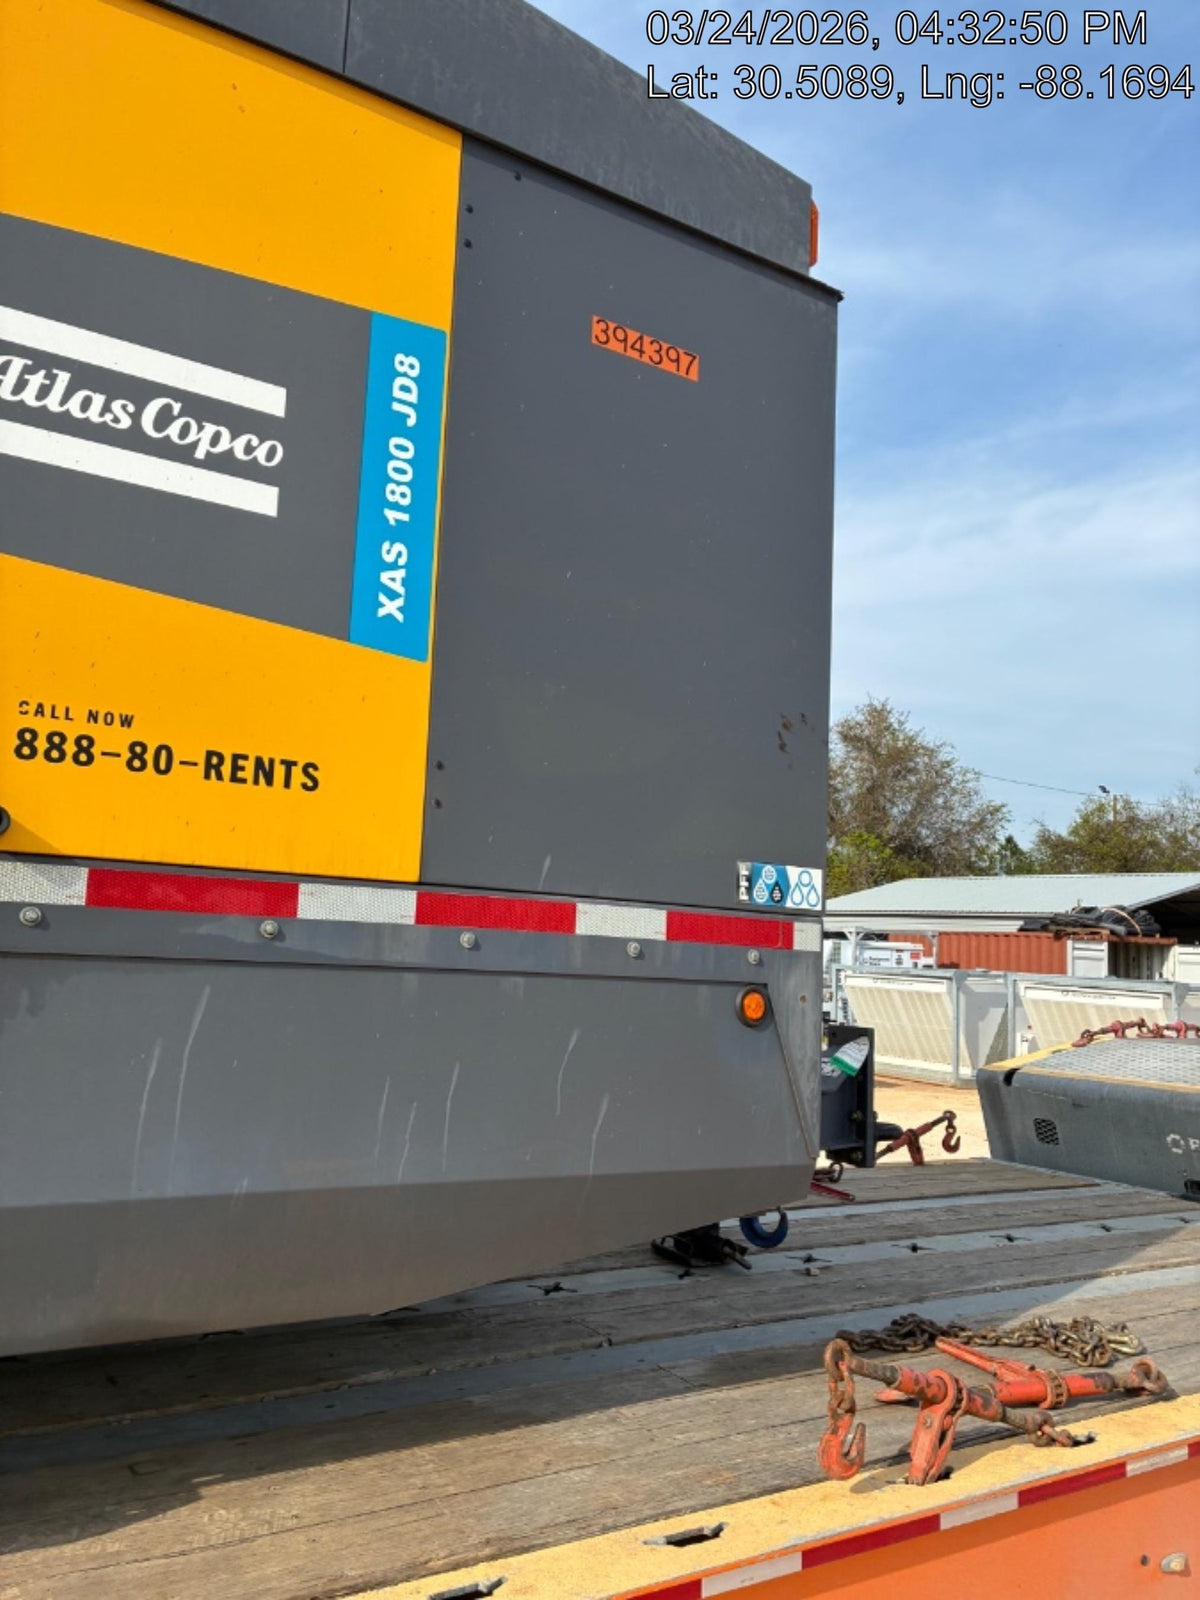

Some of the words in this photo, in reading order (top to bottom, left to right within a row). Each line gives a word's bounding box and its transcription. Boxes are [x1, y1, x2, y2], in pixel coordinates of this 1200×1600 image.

[594, 318, 698, 376] 394397
[0, 354, 134, 430] Atlas
[140, 397, 284, 468] Copco
[391, 353, 421, 427] JD8
[384, 437, 416, 527] 1800
[377, 541, 408, 623] XAS
[18, 700, 75, 721] CALL
[87, 709, 135, 729] NOW
[13, 726, 320, 792] 888-80-RENTS
